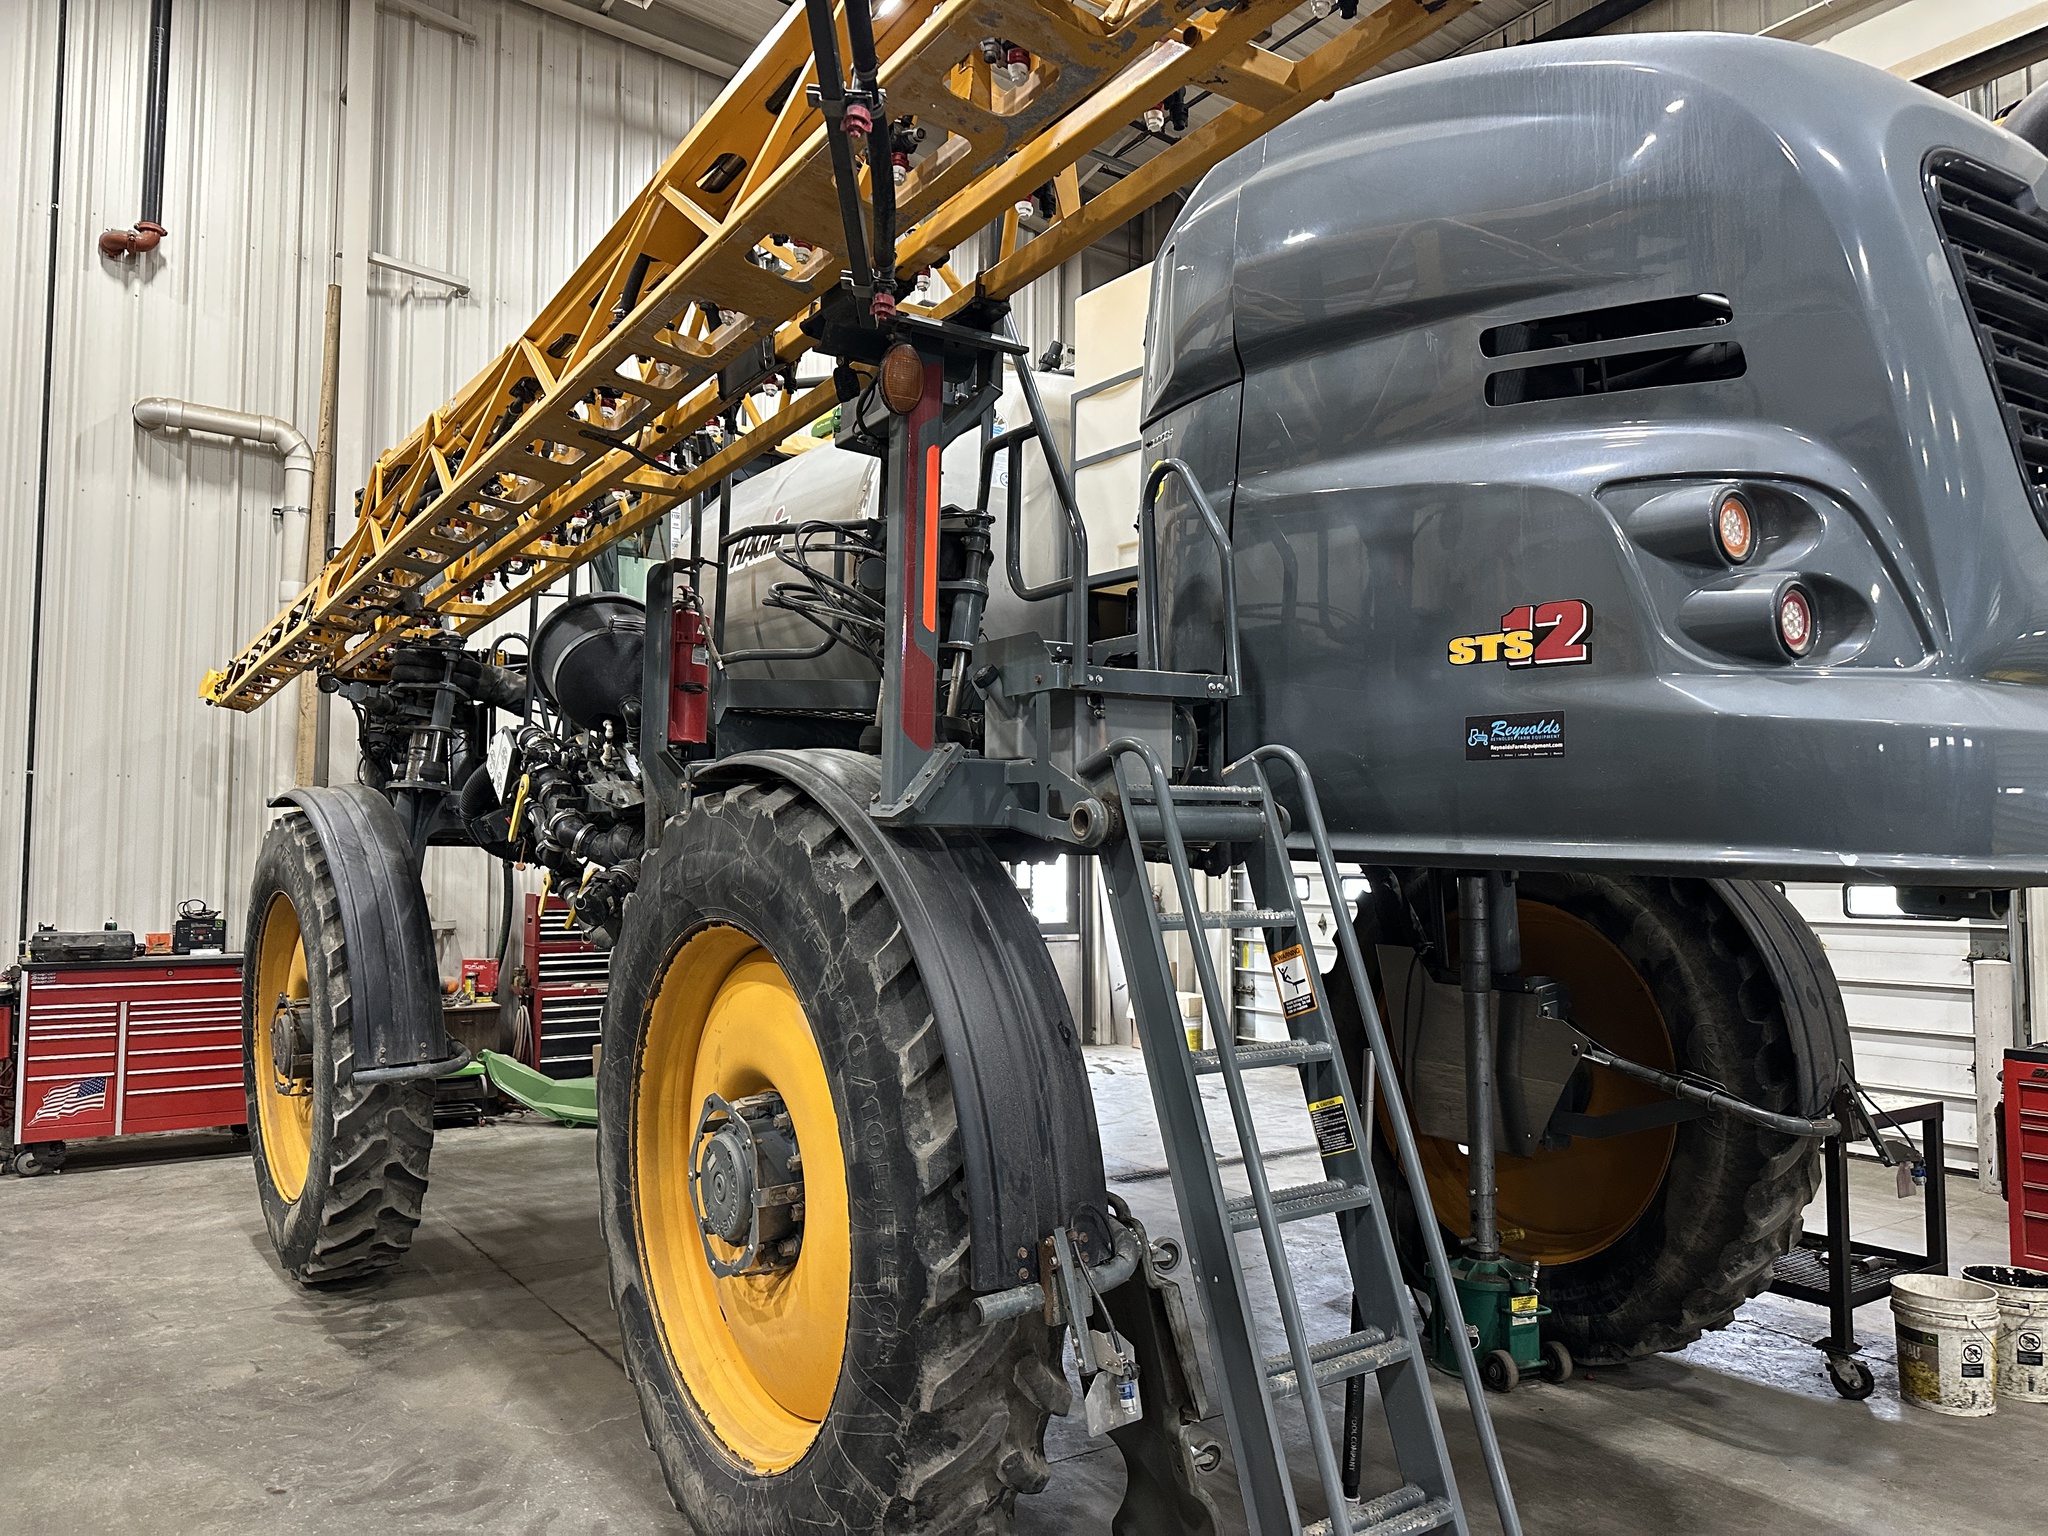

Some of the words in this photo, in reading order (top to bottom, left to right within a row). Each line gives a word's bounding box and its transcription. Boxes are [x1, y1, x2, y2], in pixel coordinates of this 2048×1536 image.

[1448, 630, 1534, 665] STS
[1501, 599, 1593, 671] 12
[1491, 719, 1561, 740] Reynolds
[1278, 948, 1300, 961] WARNING
[1348, 1436, 1358, 1472] COMPANY
